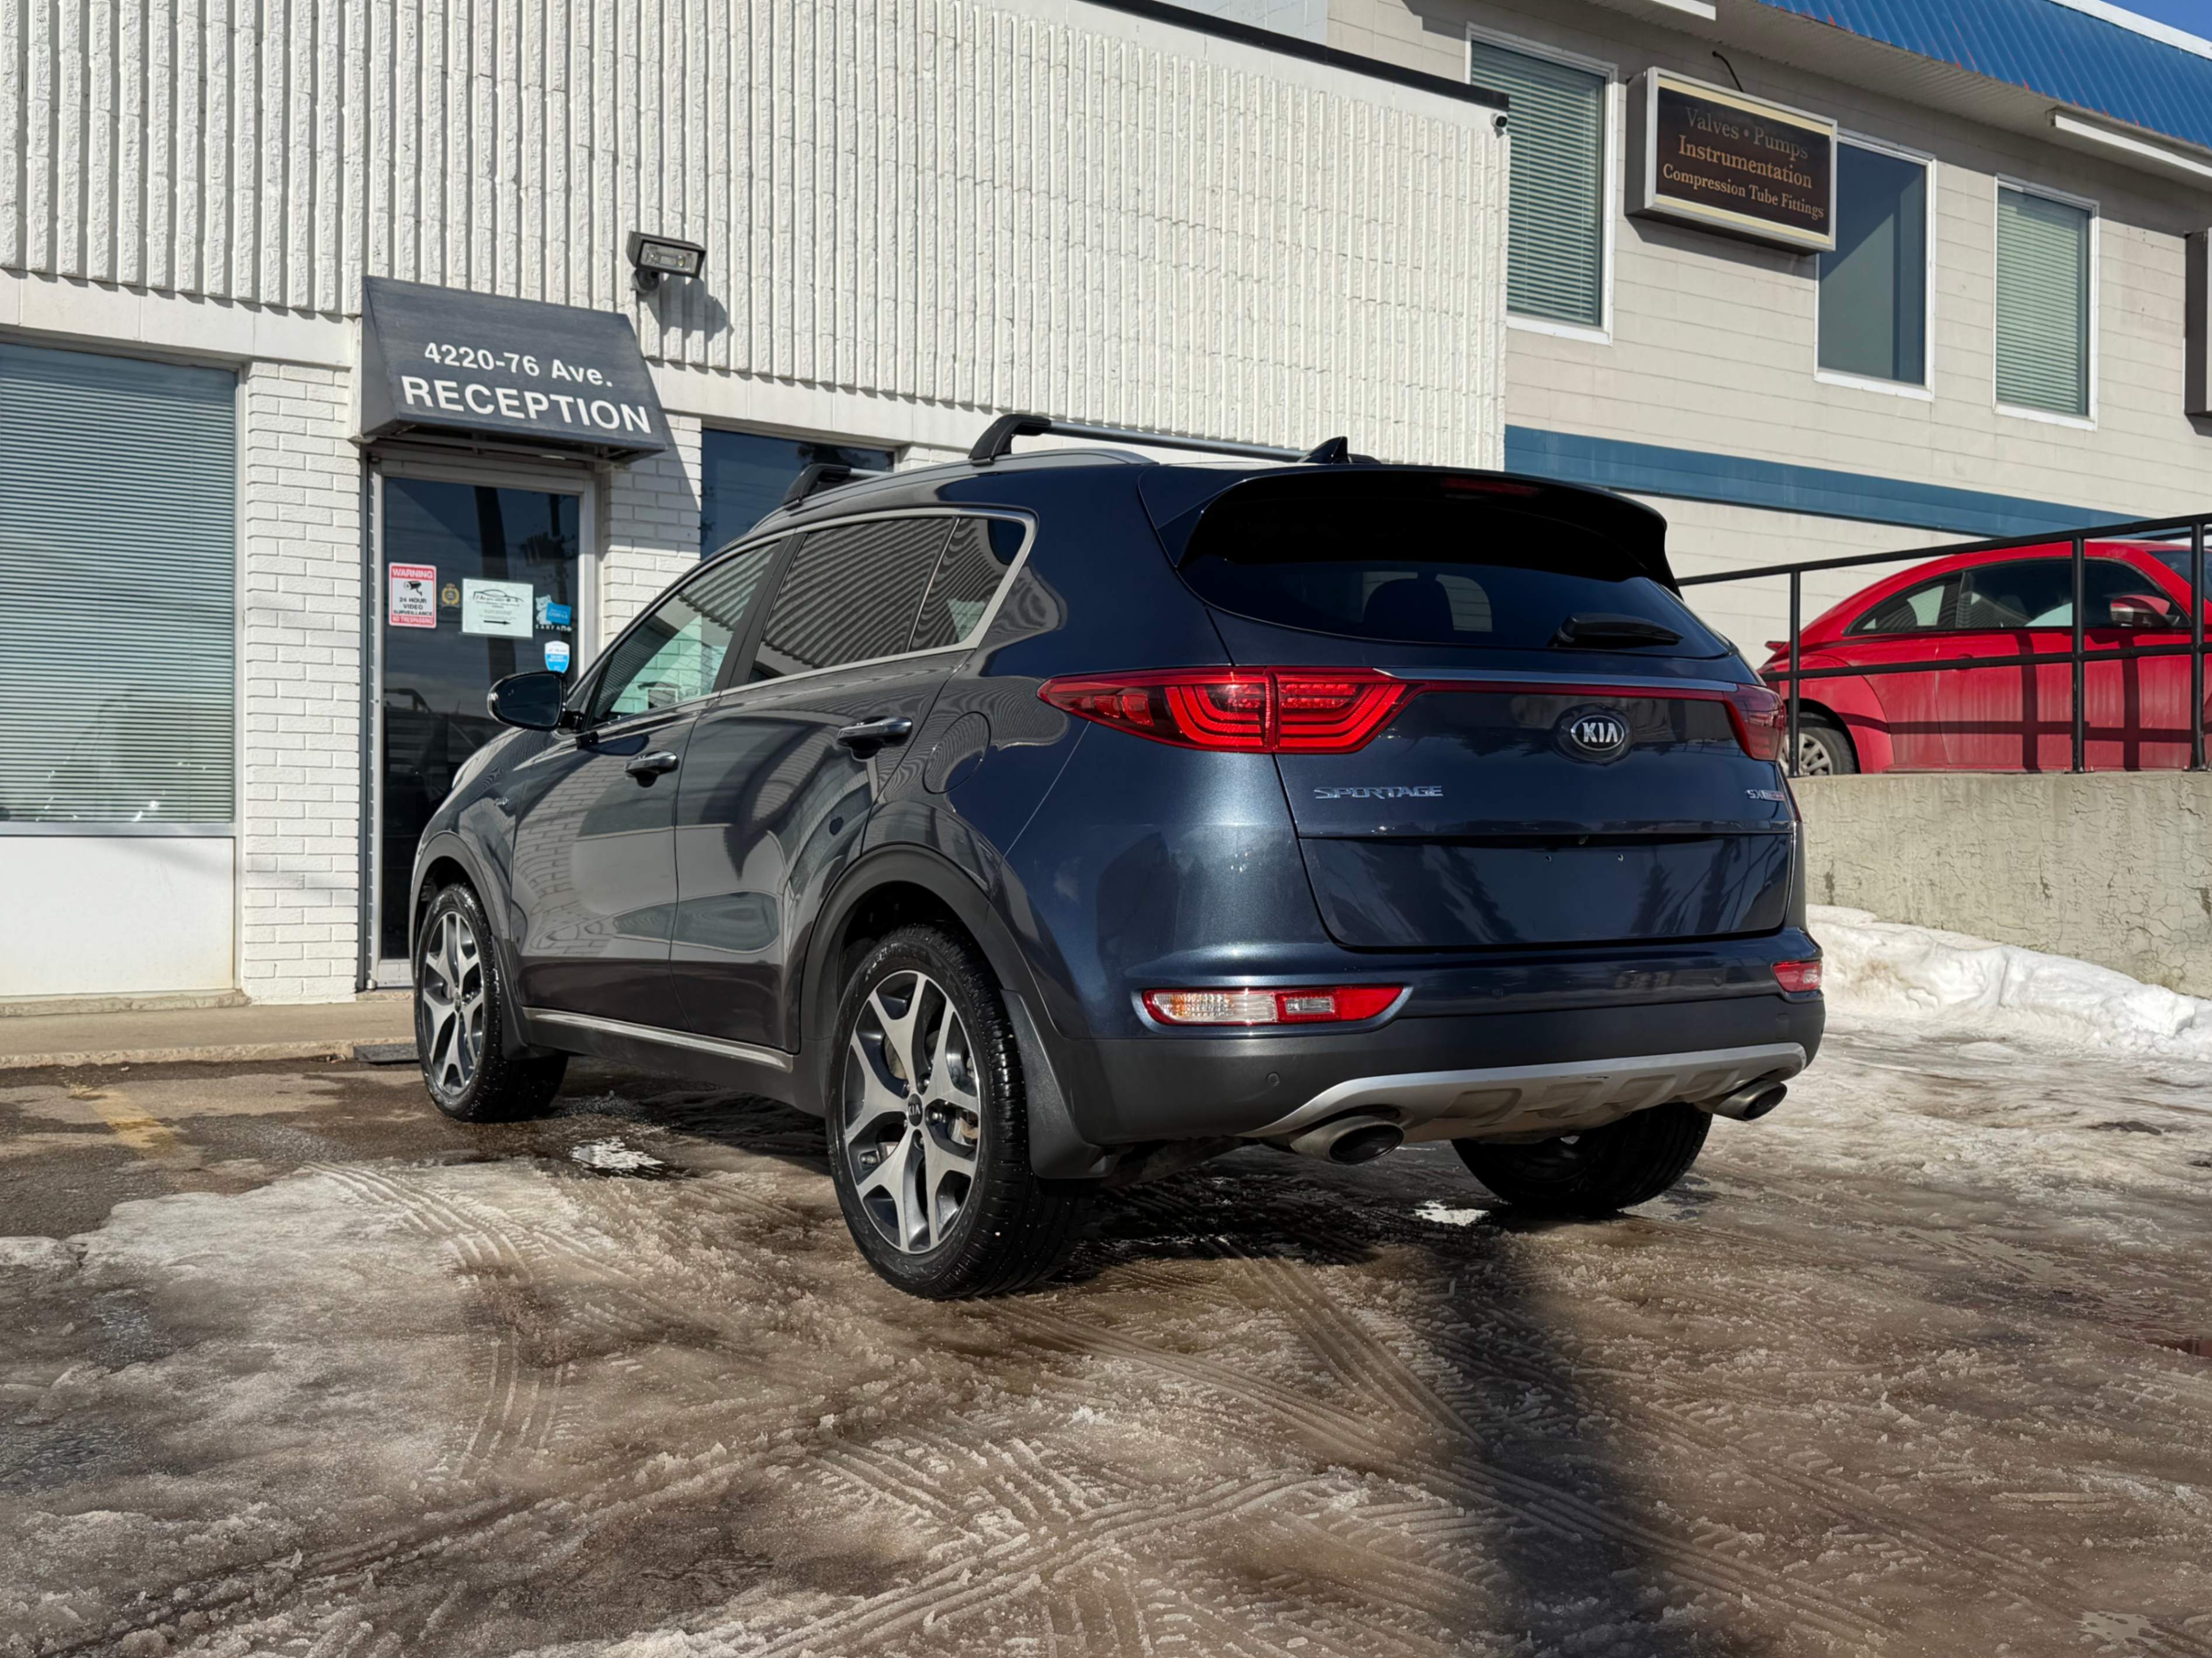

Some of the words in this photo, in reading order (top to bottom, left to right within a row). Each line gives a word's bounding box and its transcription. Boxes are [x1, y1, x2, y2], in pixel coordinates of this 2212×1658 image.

[1686, 106, 1739, 140] Valves
[1753, 126, 1808, 161] Pumps
[1678, 134, 1812, 189] Instrumentation
[1663, 163, 1746, 197] Compression
[1749, 184, 1778, 206] Tube
[1782, 193, 1824, 220] Fittings
[425, 342, 540, 377] 4220-76
[551, 359, 613, 387] Ave.
[401, 375, 652, 434] RECEPTION
[392, 568, 433, 579] WARNING
[1582, 722, 1618, 743] KIA
[1314, 785, 1444, 799] SPORTAGE
